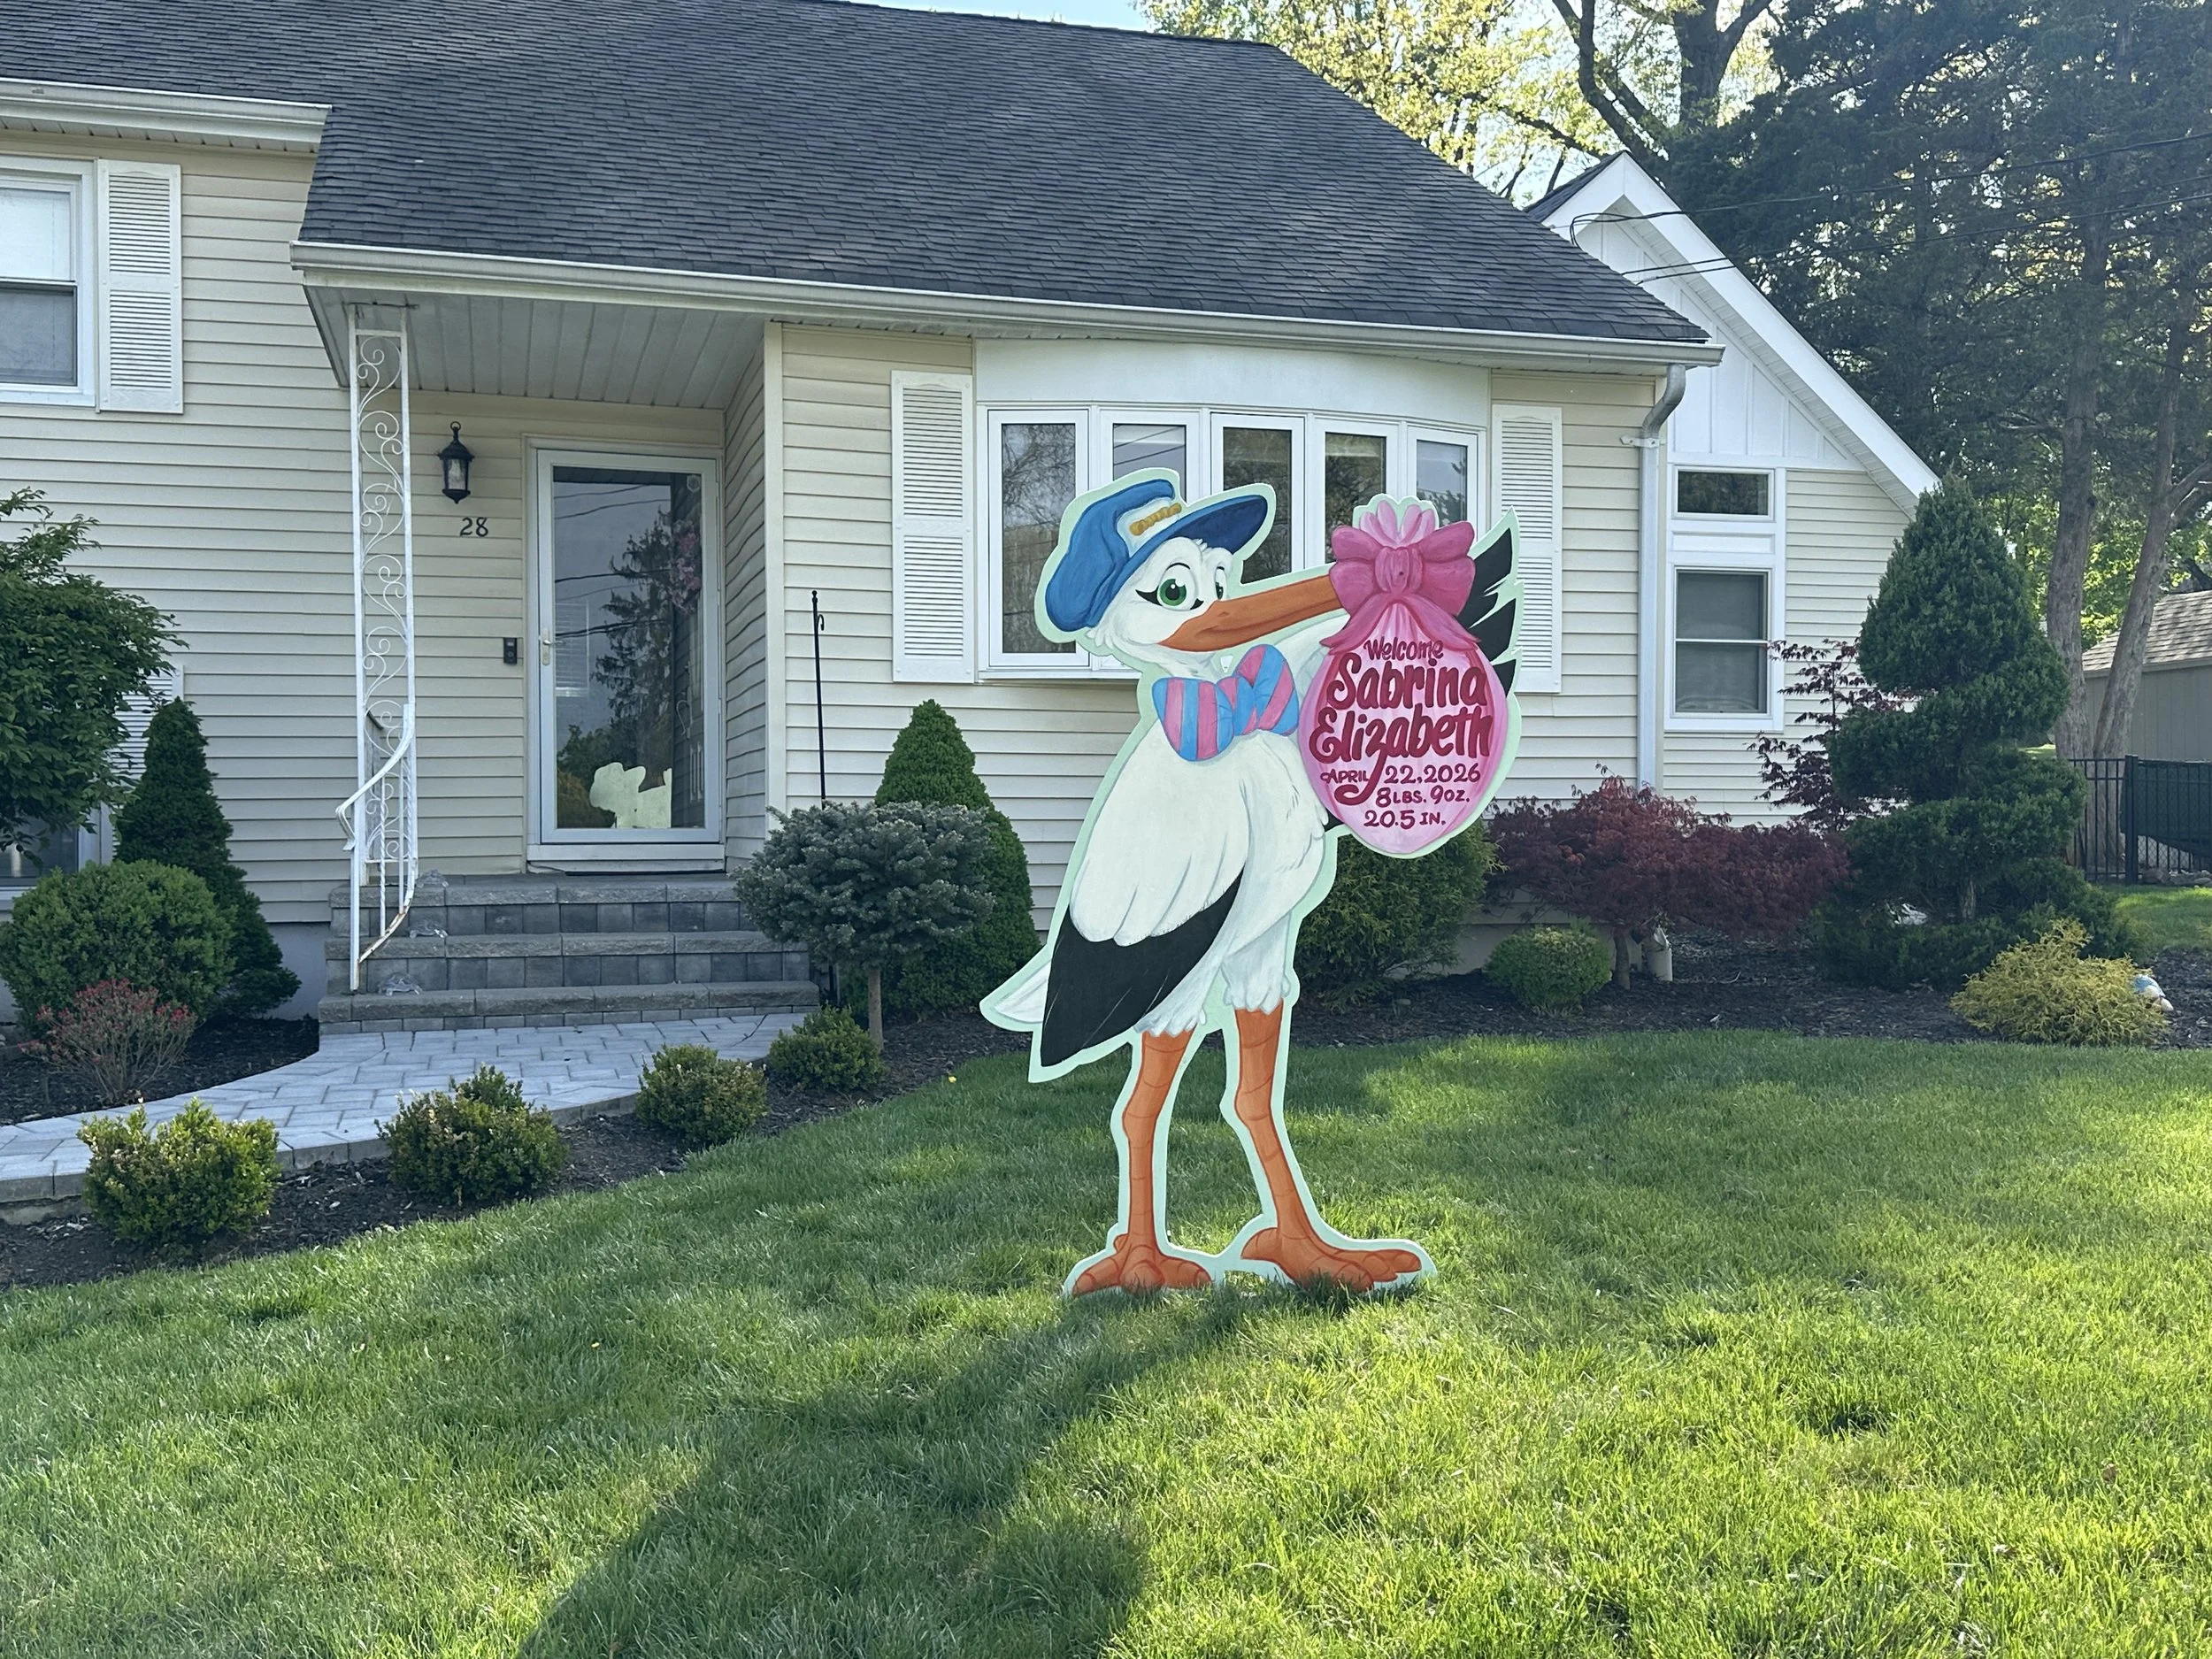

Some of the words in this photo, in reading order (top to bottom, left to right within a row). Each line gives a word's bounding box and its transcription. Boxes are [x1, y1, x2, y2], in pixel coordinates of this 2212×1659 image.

[460, 517, 488, 537] 28
[1363, 636, 1444, 661] Welcome
[1327, 652, 1487, 710] Sabrina
[1309, 703, 1494, 806] Elizabeth
[1320, 769, 1370, 784] APRIL
[1363, 810, 1416, 830] 20.5
[1419, 811, 1446, 826] IN.
